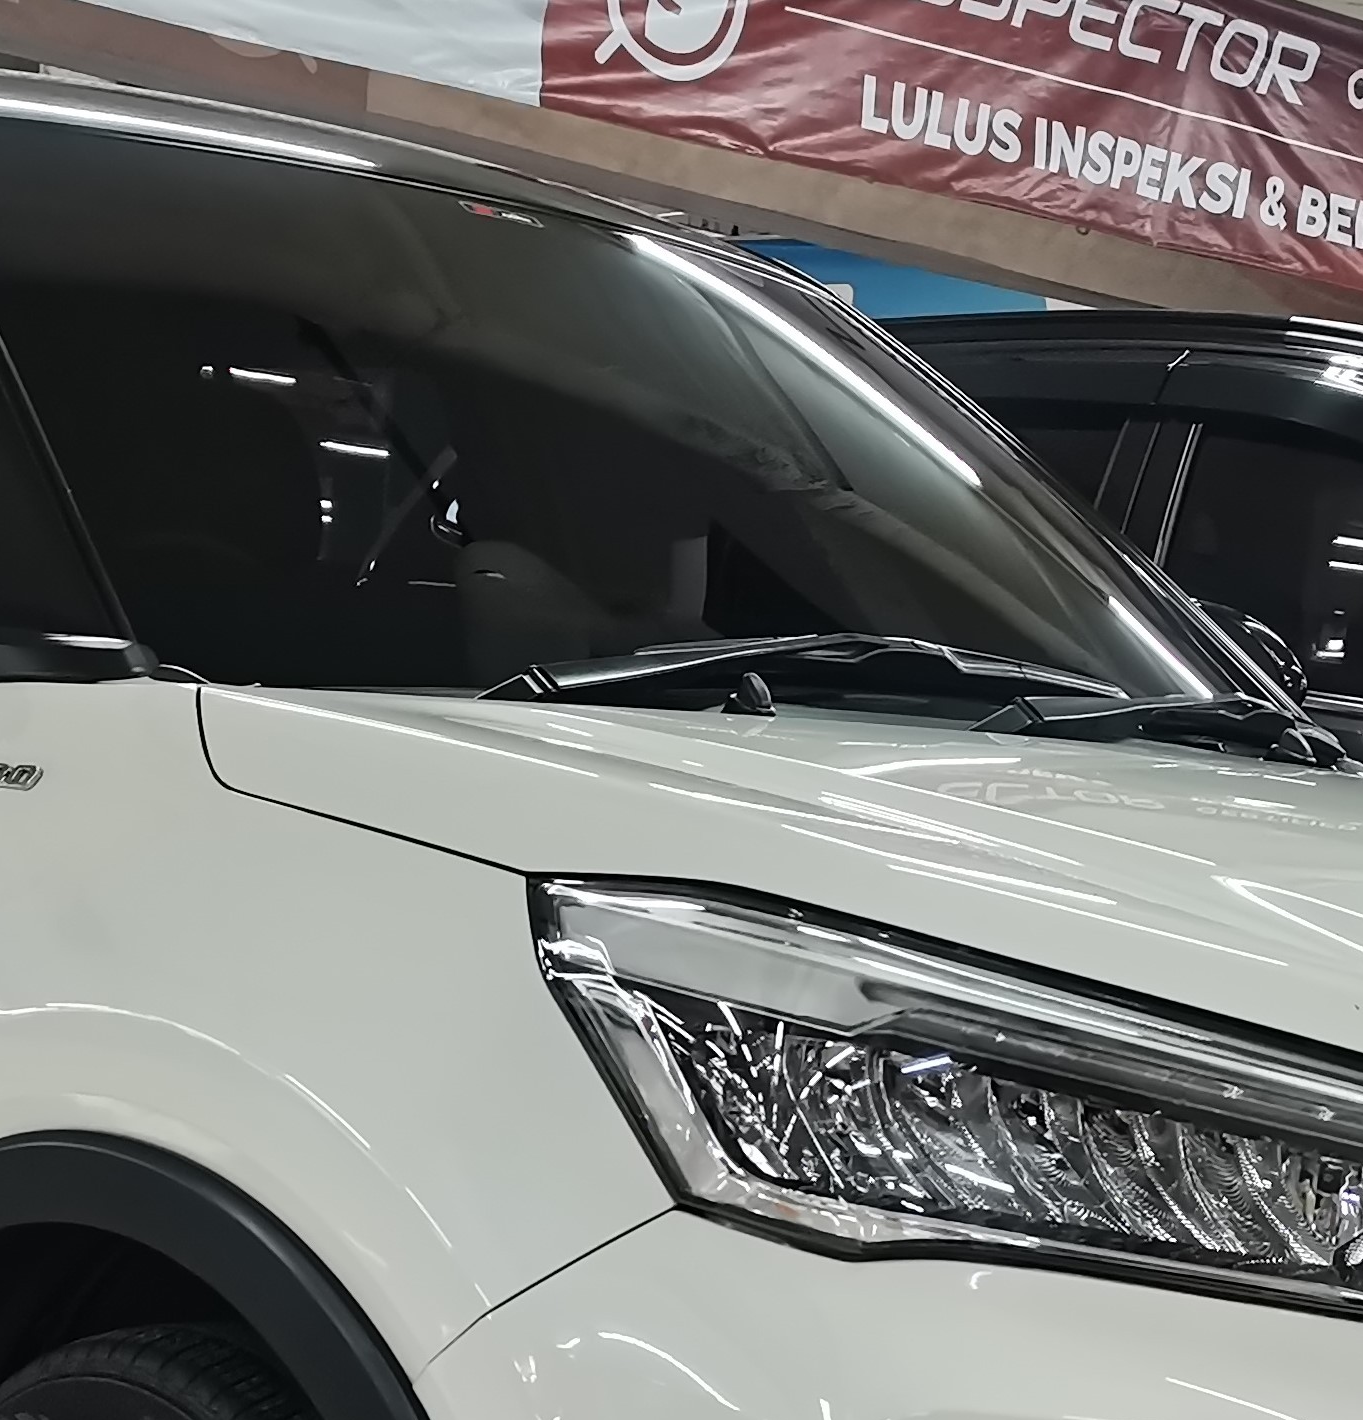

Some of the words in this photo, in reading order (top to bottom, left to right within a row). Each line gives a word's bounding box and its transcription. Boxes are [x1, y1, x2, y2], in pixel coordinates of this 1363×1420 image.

[921, 0, 1322, 106] PECTOR
[860, 74, 1023, 164] LULUS
[1033, 116, 1252, 219] INSPEKSI
[1259, 175, 1288, 231] &
